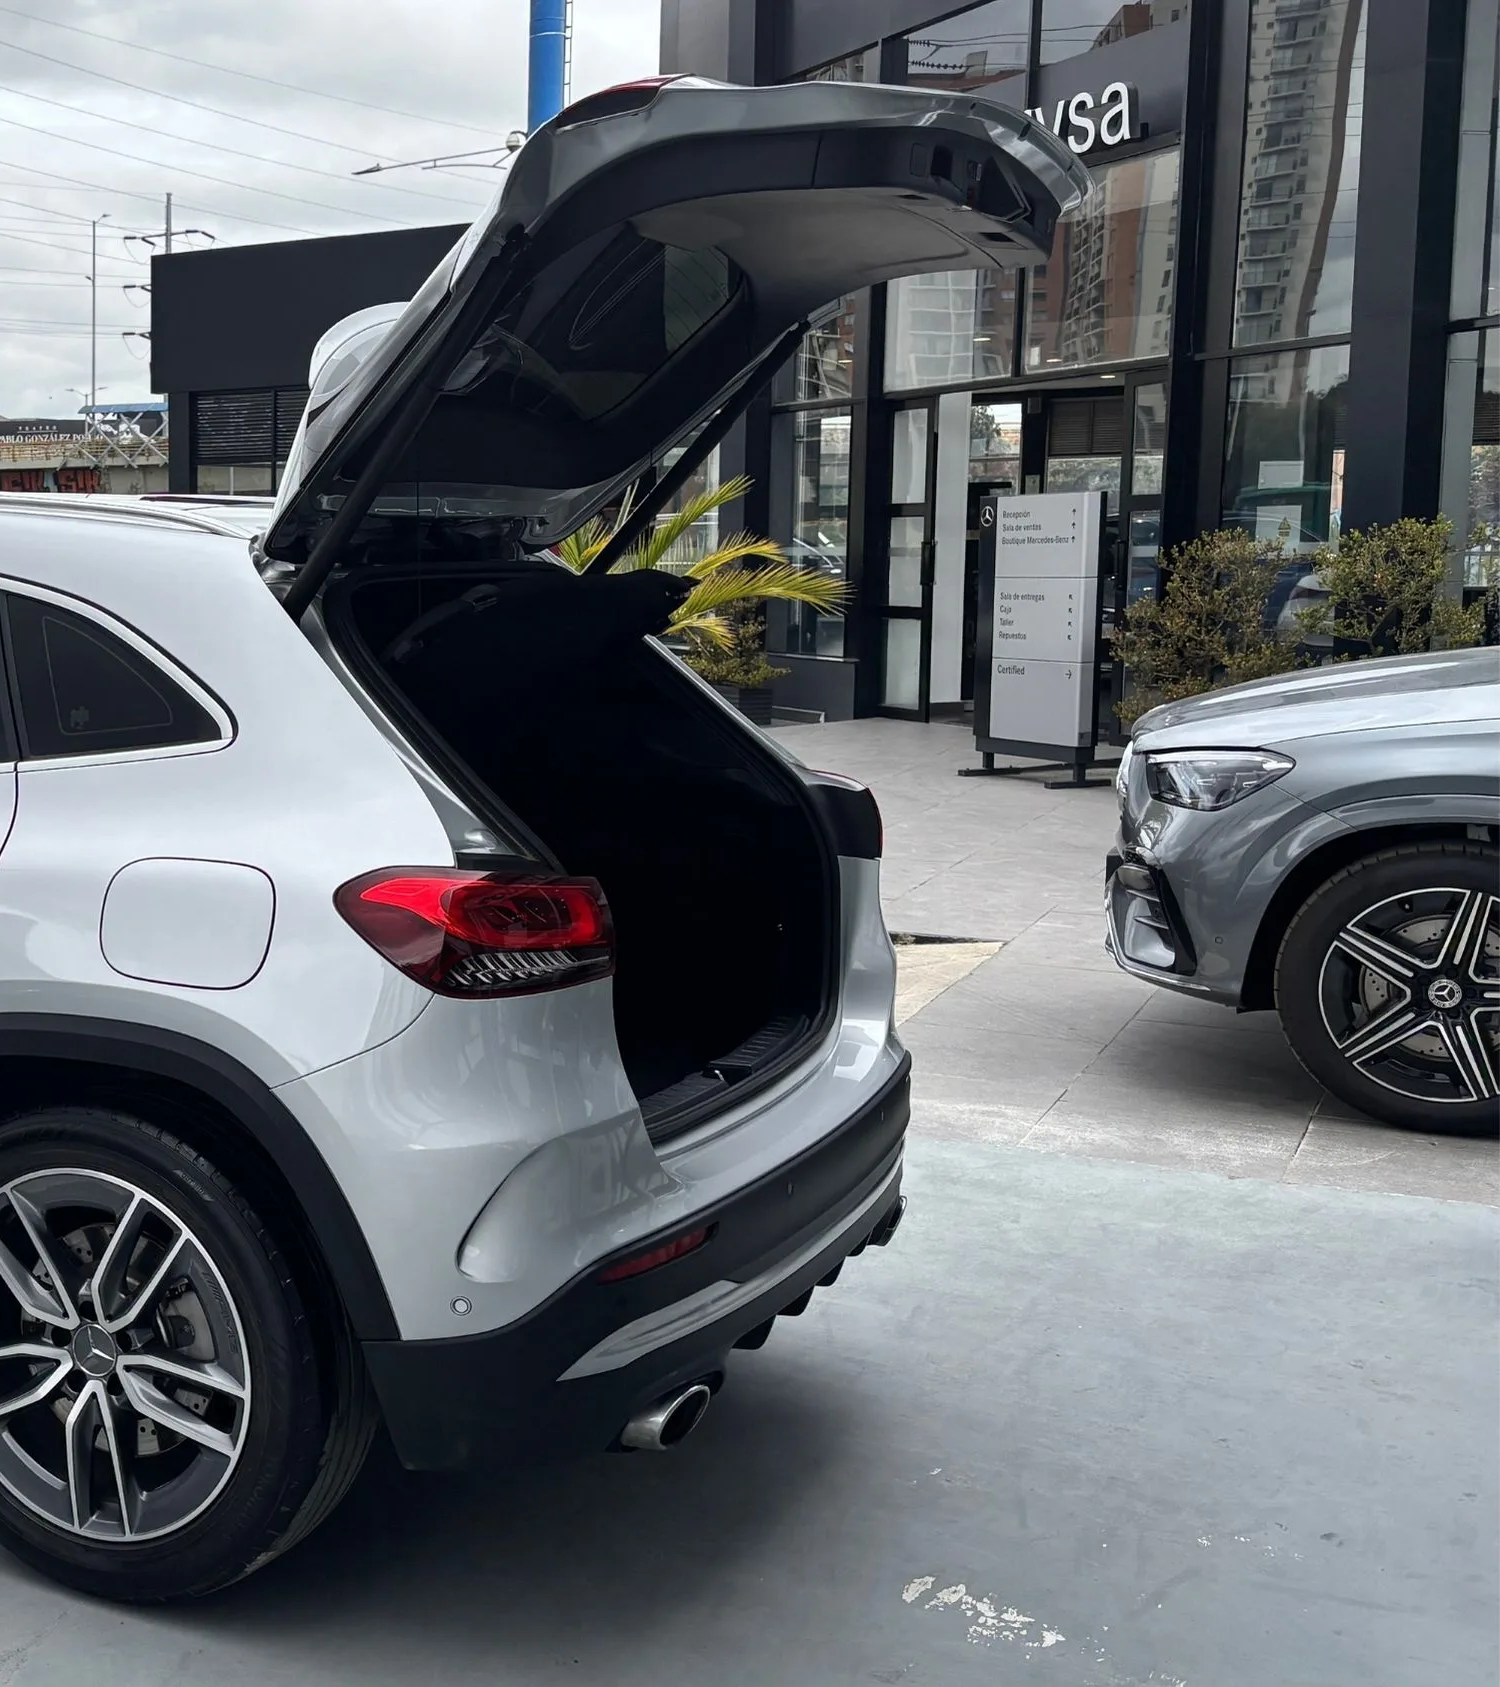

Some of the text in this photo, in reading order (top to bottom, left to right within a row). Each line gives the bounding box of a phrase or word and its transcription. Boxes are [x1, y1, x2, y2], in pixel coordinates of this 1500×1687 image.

[25, 432, 71, 443] GONZÁLEZ
[1002, 509, 1031, 519] Recepción
[1002, 524, 1014, 532] Sala
[1001, 535, 1069, 546] Boutique Mercedes-Benz
[1000, 592, 1045, 602] Sala de entregas
[999, 605, 1012, 615] Caja
[999, 618, 1014, 626] Taller
[998, 630, 1027, 640] Repuestos
[997, 664, 1025, 675] Certified
